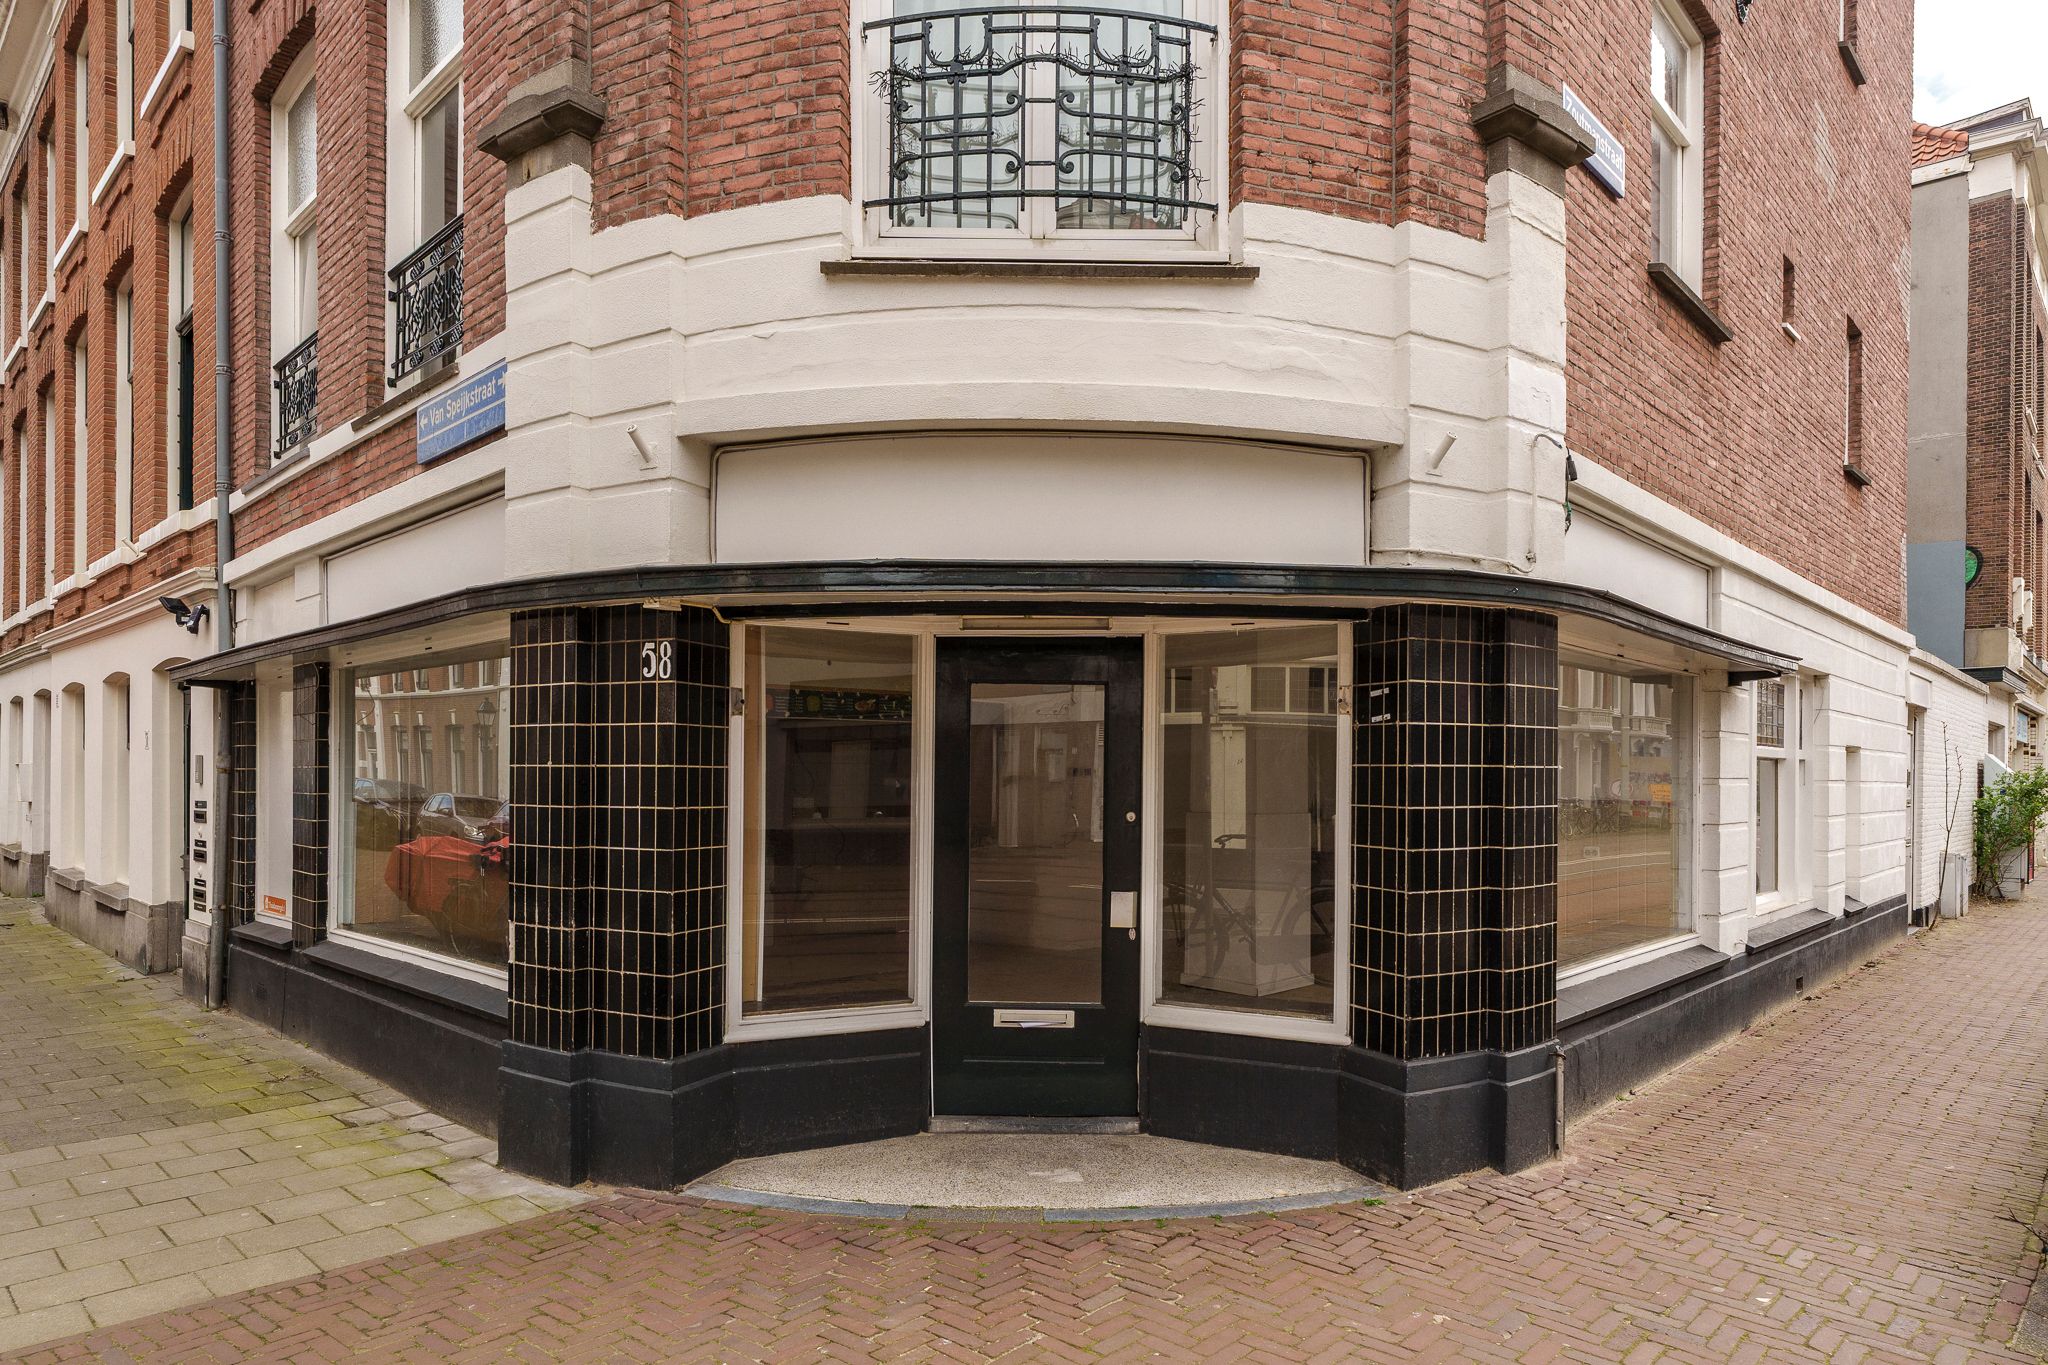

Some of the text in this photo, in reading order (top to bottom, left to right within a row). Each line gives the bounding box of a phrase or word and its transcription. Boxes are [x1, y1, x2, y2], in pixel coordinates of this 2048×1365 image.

[430, 406, 444, 426] Van
[446, 376, 496, 420] Speijkstraat
[642, 641, 672, 679] 58
